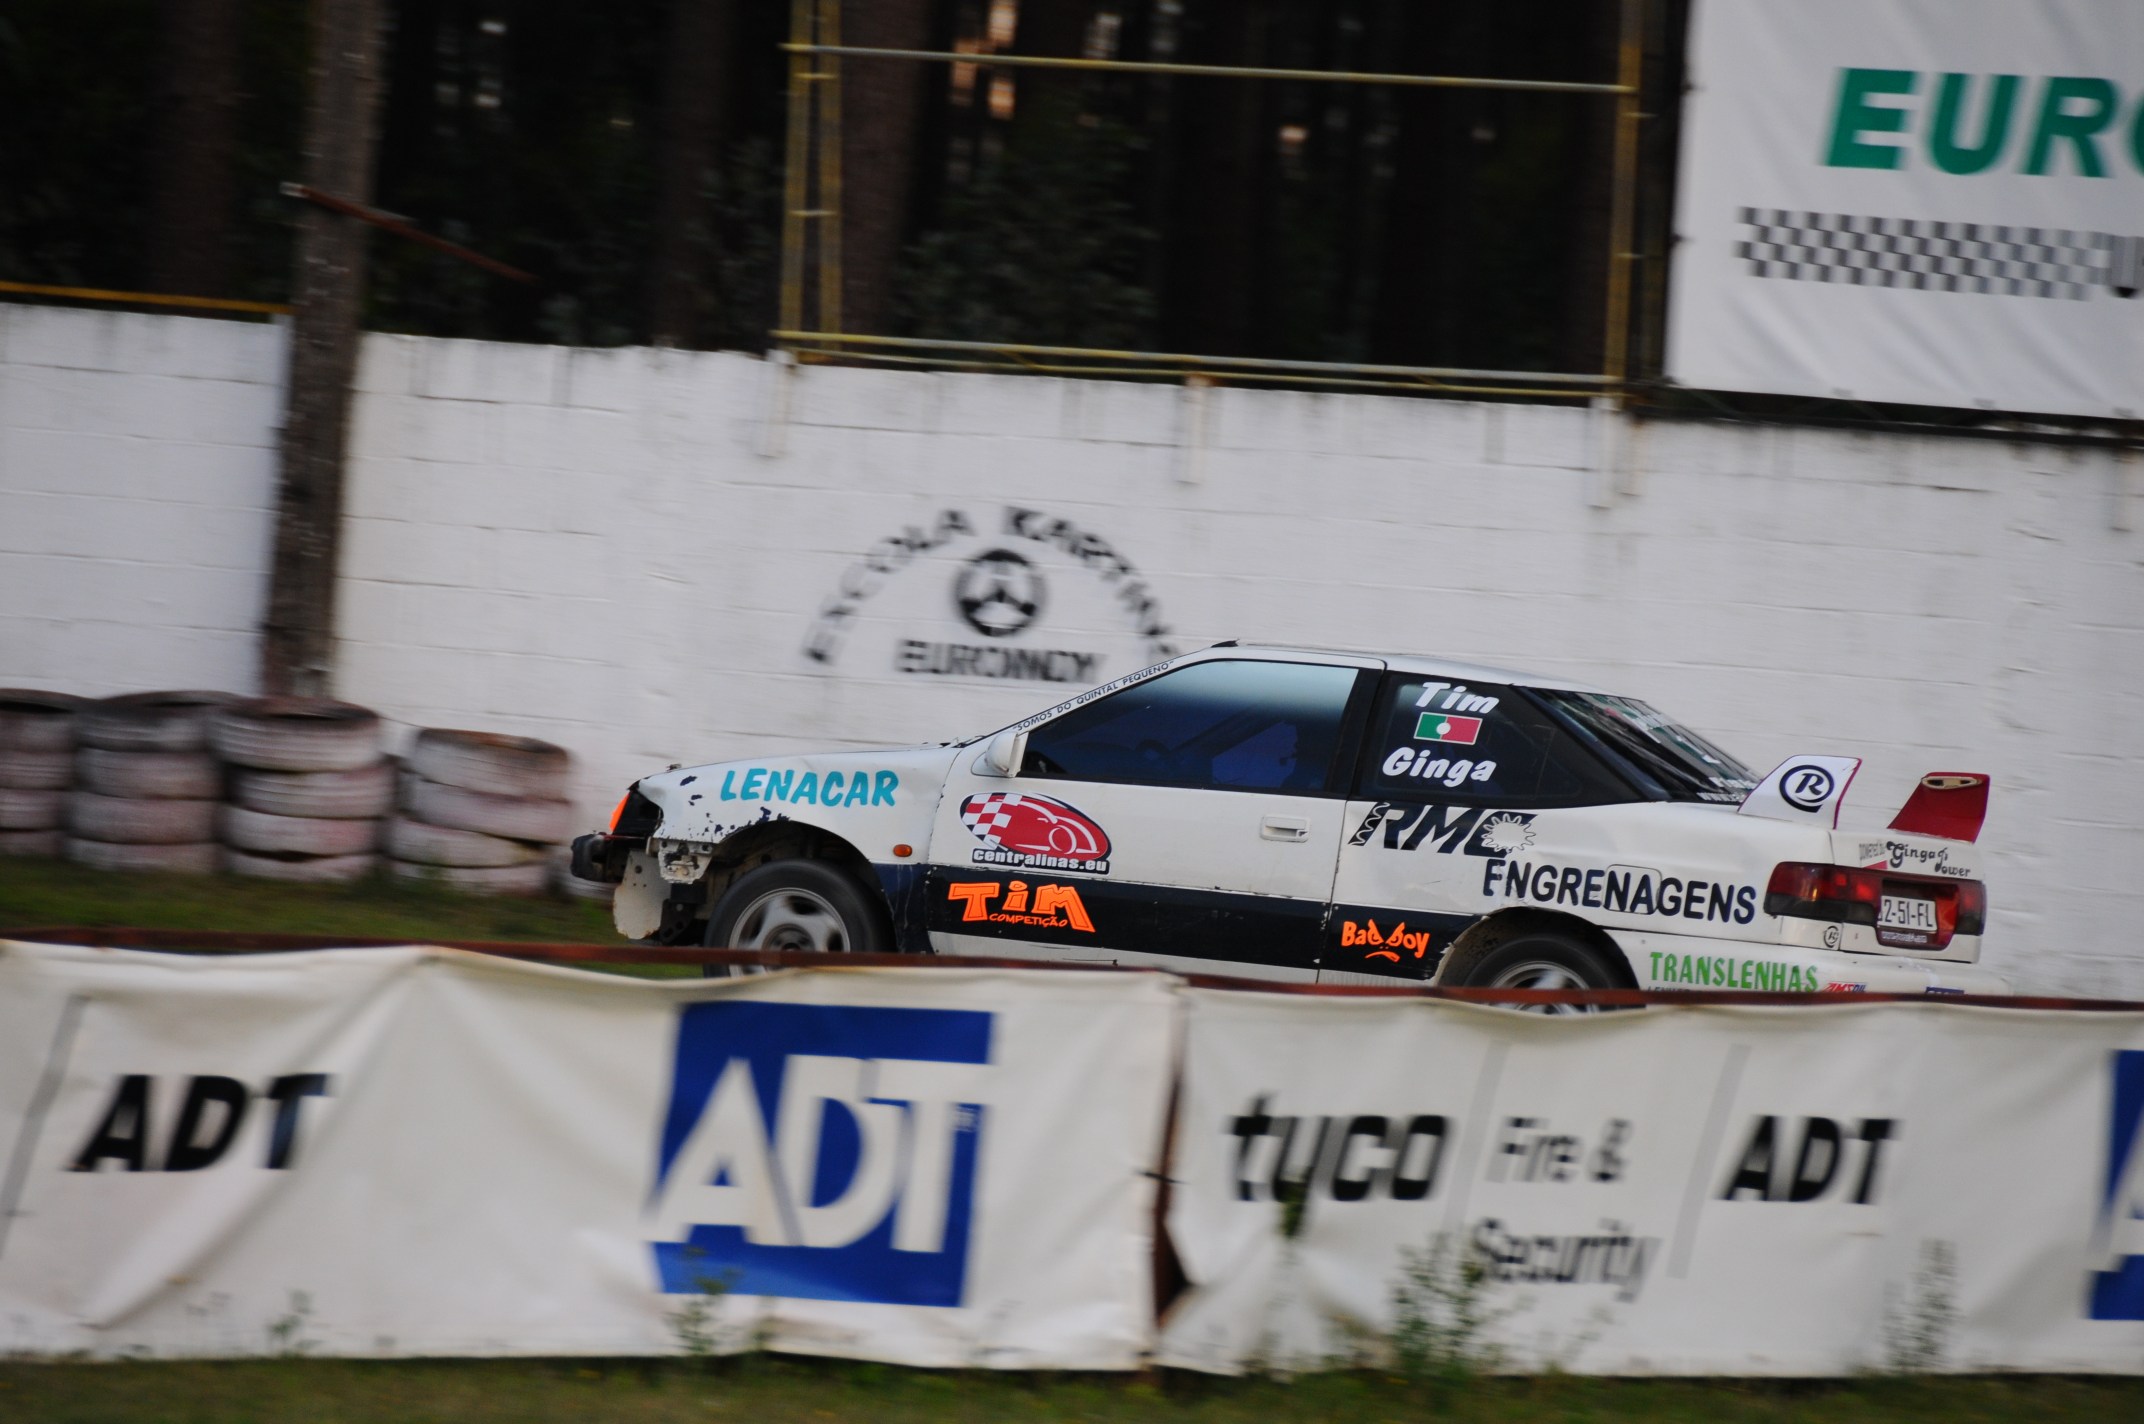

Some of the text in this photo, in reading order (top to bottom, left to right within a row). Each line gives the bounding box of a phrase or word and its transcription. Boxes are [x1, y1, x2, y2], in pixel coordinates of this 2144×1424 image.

[1056, 702, 1072, 715] DO
[1076, 683, 1118, 705] QUINTAL
[1416, 682, 1499, 714] Tim
[1382, 747, 1497, 787] Ginga
[720, 768, 899, 807] LENACAR
[972, 848, 1108, 873] centralinas.eu
[1886, 841, 1935, 868] Ginga
[1483, 858, 1757, 925] ENGRENAGENS
[1650, 952, 1818, 992] TRANSLENHAS
[64, 1073, 330, 1172] ADT
[645, 1054, 1000, 1254] ADT
[1226, 1095, 1452, 1238] tyco
[1487, 1116, 1578, 1182] Fire
[1719, 1114, 1901, 1205] ADT
[1478, 1217, 1664, 1302] Security
